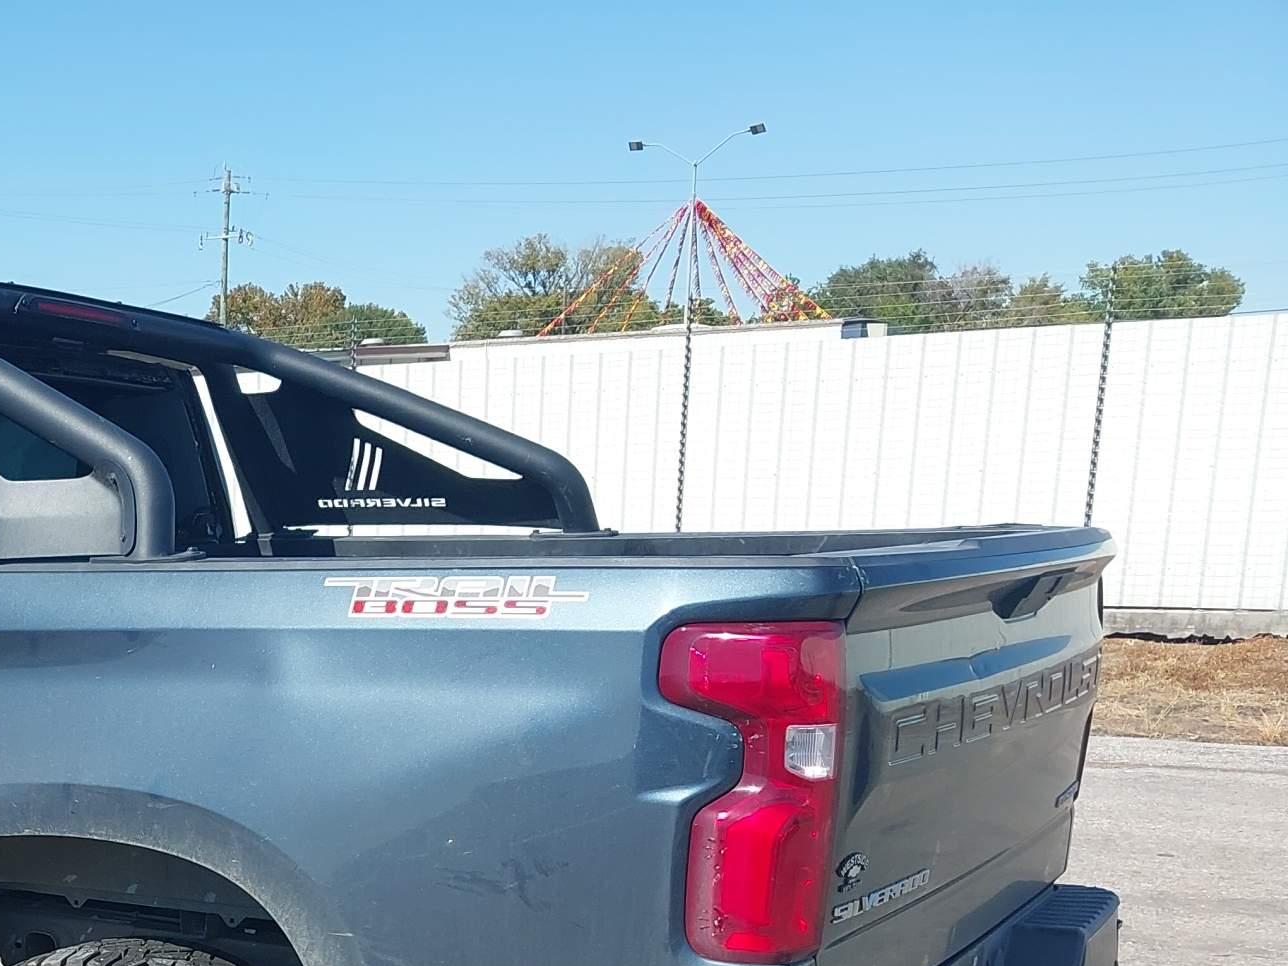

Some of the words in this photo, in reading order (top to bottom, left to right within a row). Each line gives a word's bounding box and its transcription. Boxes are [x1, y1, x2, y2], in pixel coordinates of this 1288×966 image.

[323, 576, 590, 601] TRAIL
[349, 598, 550, 617] BOSS
[831, 867, 931, 925] SILVERADO
